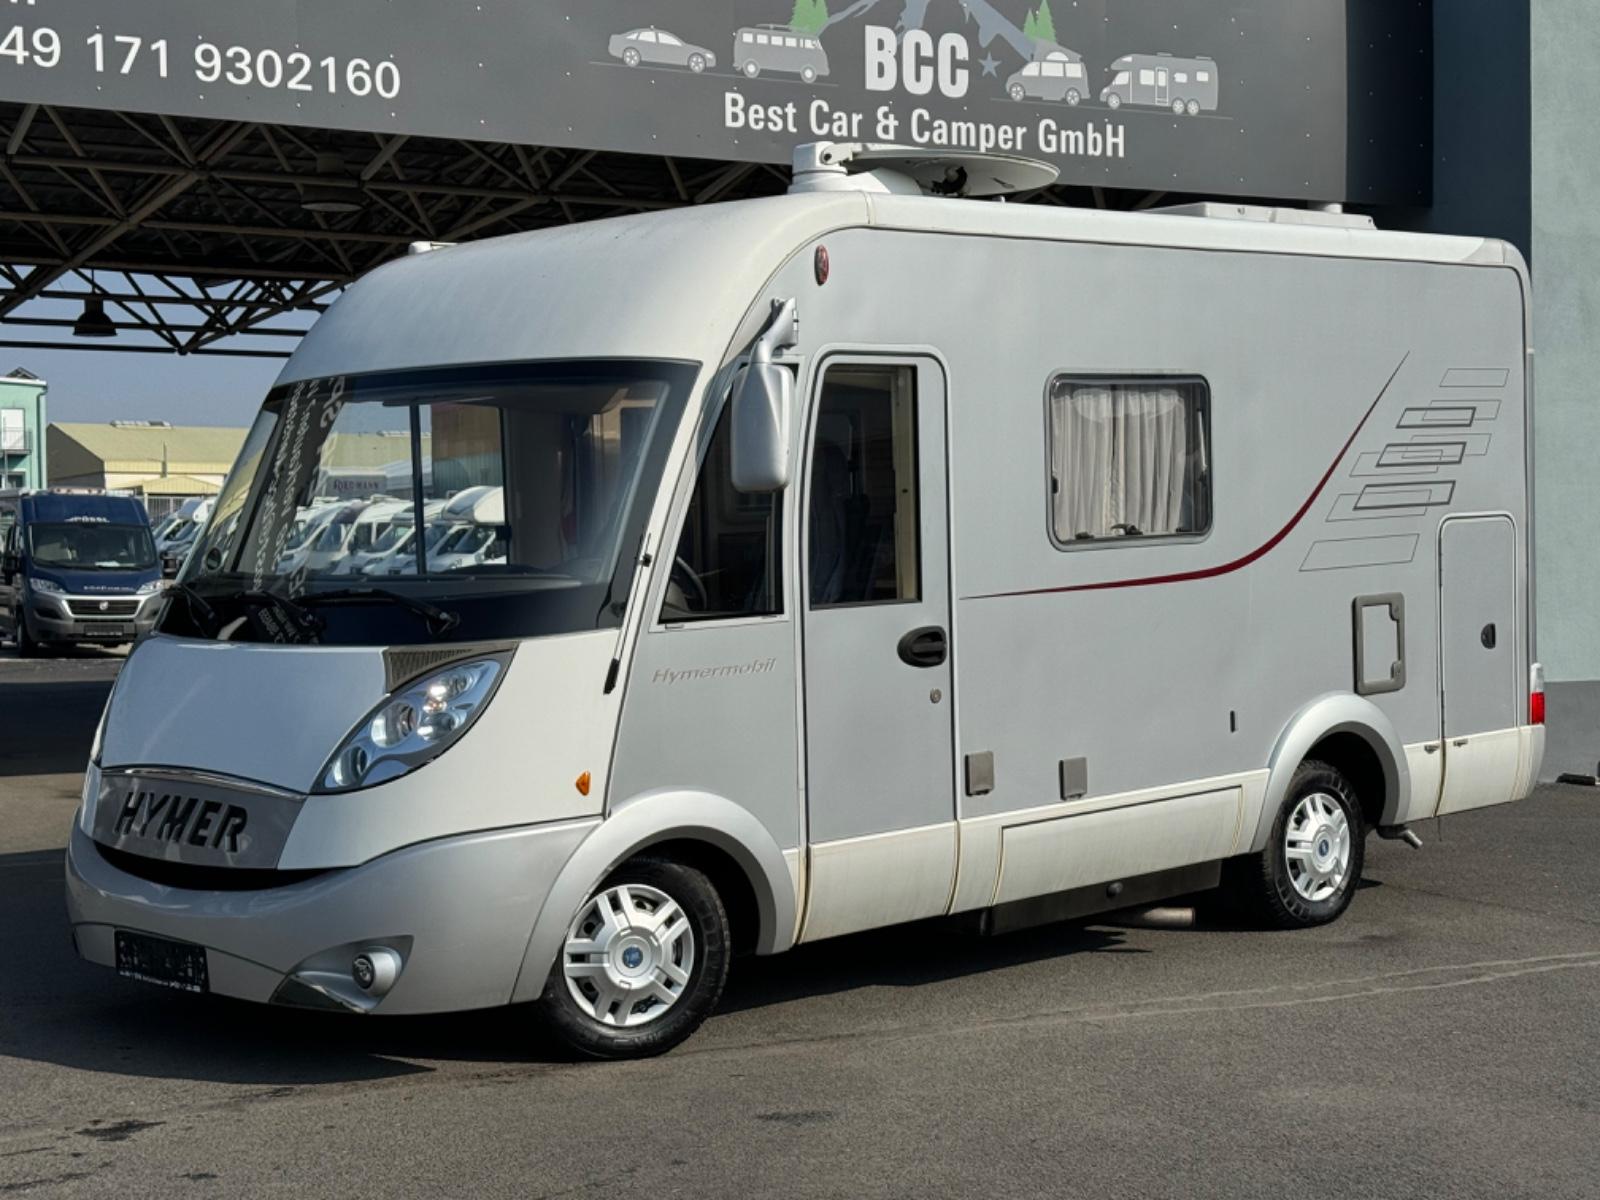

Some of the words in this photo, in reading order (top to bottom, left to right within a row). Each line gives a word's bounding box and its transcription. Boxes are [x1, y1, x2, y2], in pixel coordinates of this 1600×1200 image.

[86, 33, 168, 78] 171
[194, 43, 400, 98] 9302160
[865, 25, 969, 98] BCC
[724, 91, 797, 133] Best
[809, 99, 863, 138] Car
[875, 105, 899, 141] &
[910, 108, 1027, 153] Camper
[1038, 118, 1125, 158] GmbH
[652, 657, 776, 685] Hymermobil
[114, 791, 248, 853] HYMER
